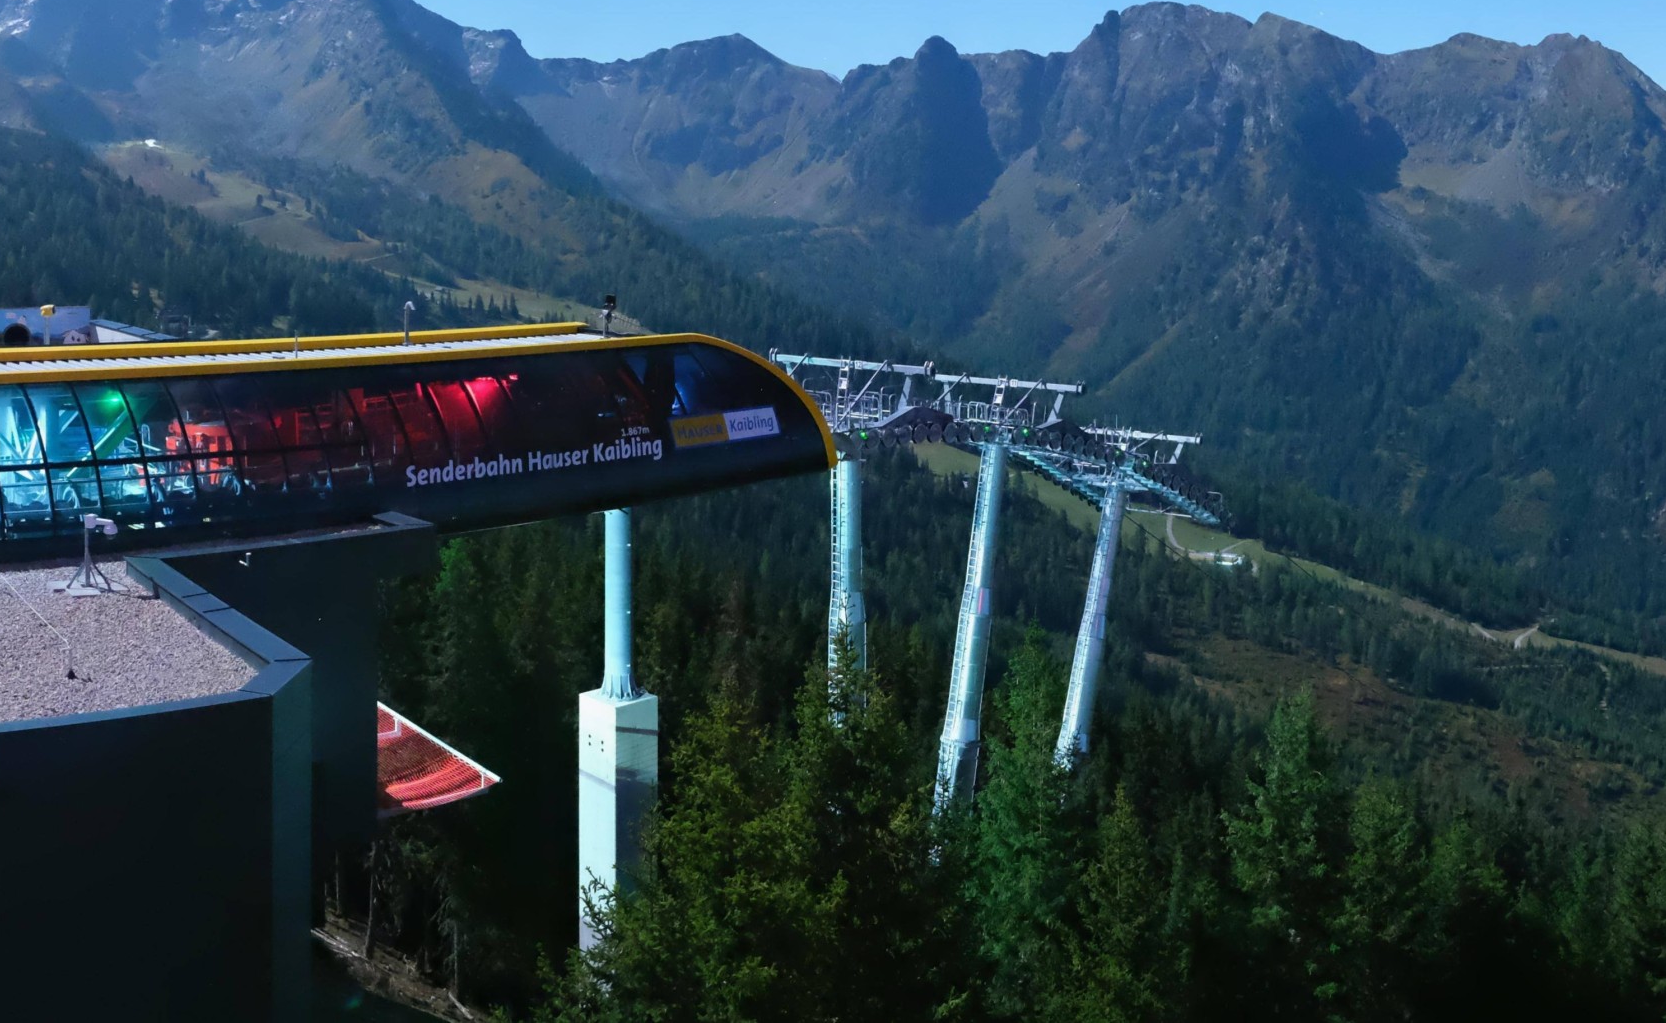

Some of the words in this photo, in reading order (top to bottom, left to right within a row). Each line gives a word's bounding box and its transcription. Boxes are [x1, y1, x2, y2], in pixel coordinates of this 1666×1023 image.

[620, 424, 650, 437] 1.867m
[729, 415, 774, 433] Kaibling
[405, 453, 523, 488] Senderbahn
[528, 444, 589, 472] Hauser
[593, 437, 663, 463] Kaibling
